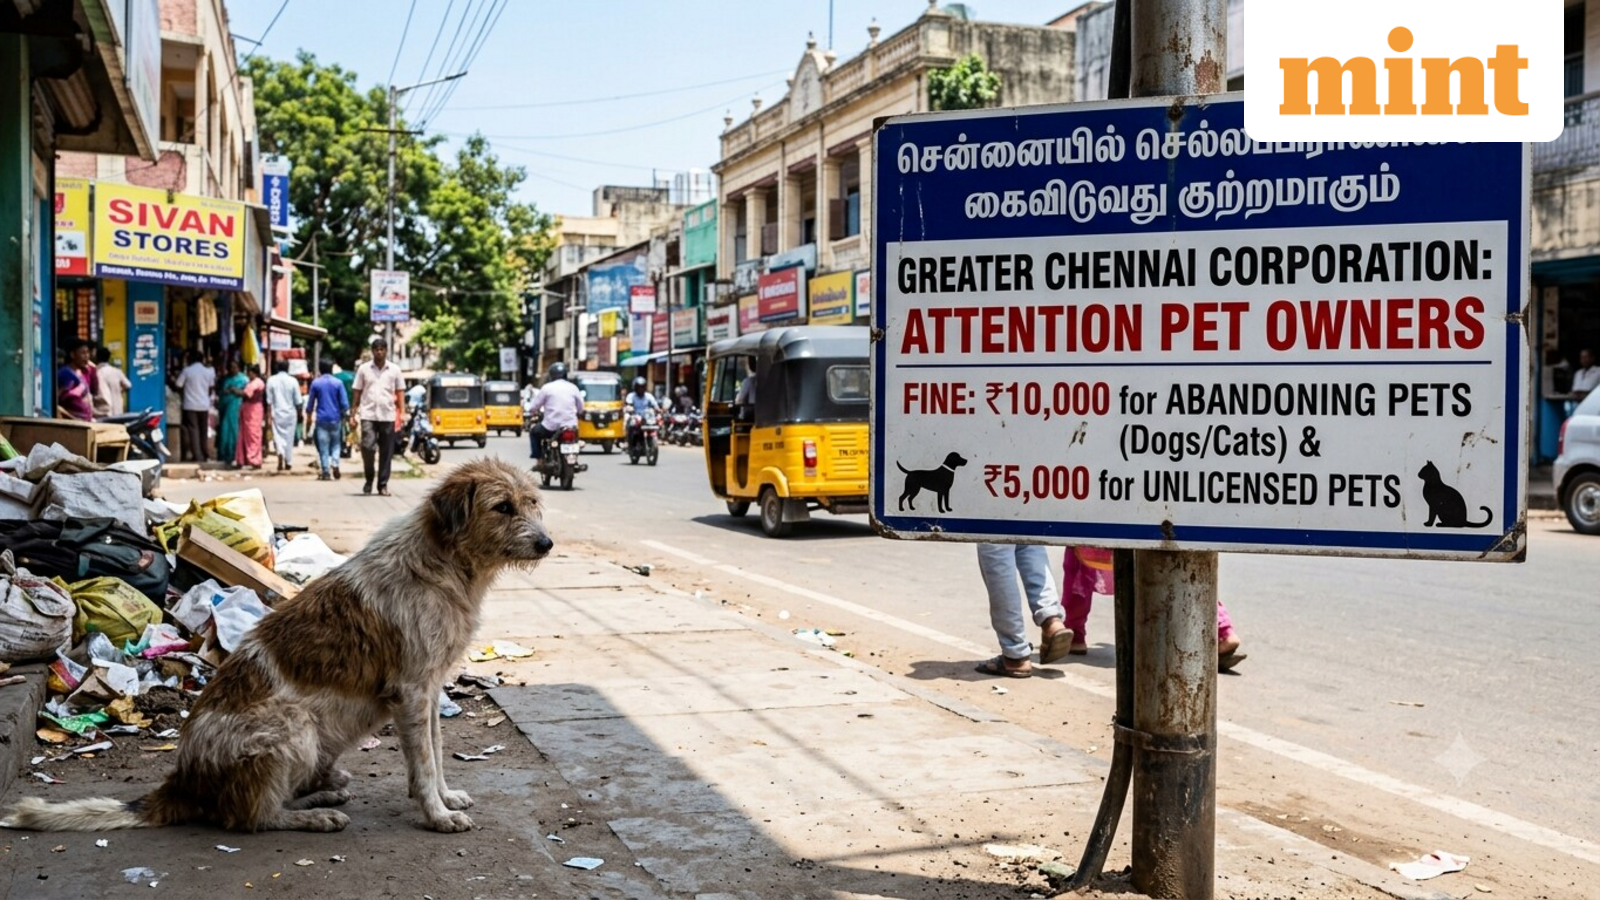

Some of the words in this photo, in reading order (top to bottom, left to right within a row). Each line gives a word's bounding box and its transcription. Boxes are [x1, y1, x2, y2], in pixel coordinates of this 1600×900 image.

[898, 124, 1126, 174] சென்னையில்
[965, 178, 1167, 225] கைவிடுவது
[1178, 162, 1401, 221] குற்றமாகும்
[109, 199, 233, 237] SIVAN
[114, 230, 229, 259] STORES
[898, 254, 1034, 294] GREATER
[1045, 248, 1196, 290] CHENNAI
[1210, 240, 1491, 286] CORPORATION:
[901, 304, 1142, 354] ATTENTION
[1161, 302, 1249, 351] PET
[1267, 296, 1484, 350] OWNERS
[904, 383, 975, 414] FINE:
[986, 382, 1109, 421] ₹10,000
[1119, 385, 1157, 415] for
[1166, 383, 1375, 416] ABANDONING
[1389, 383, 1471, 417] PETS
[1120, 424, 1287, 463] (Dogs/Cats)
[1299, 426, 1321, 457] &
[984, 465, 1089, 504] ₹5,000
[1099, 469, 1134, 501] for
[1144, 470, 1317, 505] UNLICENSED
[1329, 474, 1401, 508] PETS
